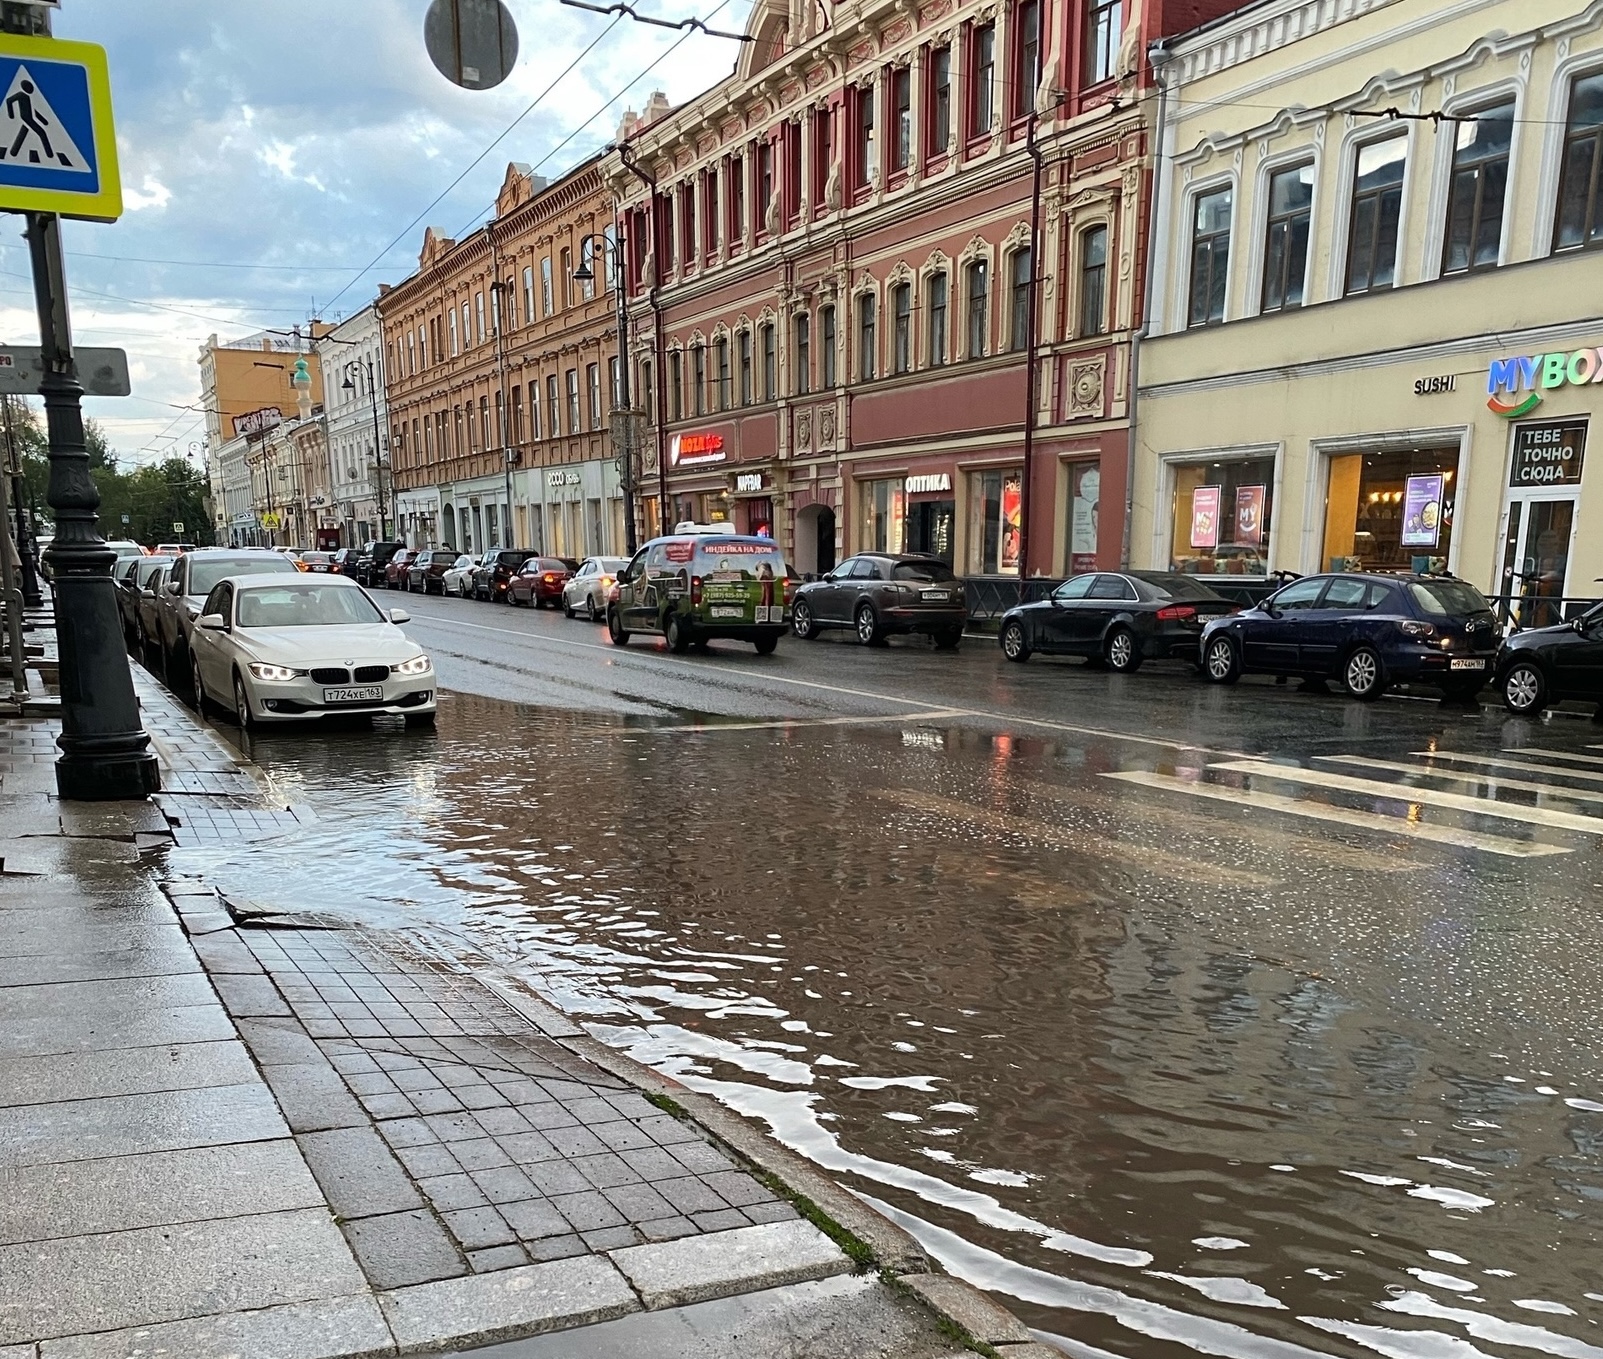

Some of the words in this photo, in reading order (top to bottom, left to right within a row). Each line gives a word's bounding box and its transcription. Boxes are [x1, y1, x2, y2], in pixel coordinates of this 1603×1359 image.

[1414, 375, 1456, 395] SUSHI
[1525, 429, 1562, 444] ТЕБЕ
[1523, 446, 1573, 462] ТОЧНО
[1521, 466, 1564, 481] СЮДА
[905, 473, 951, 493] ОПТИКА
[705, 545, 742, 553] ИНДЕЙКА
[754, 546, 772, 554] ДОМ
